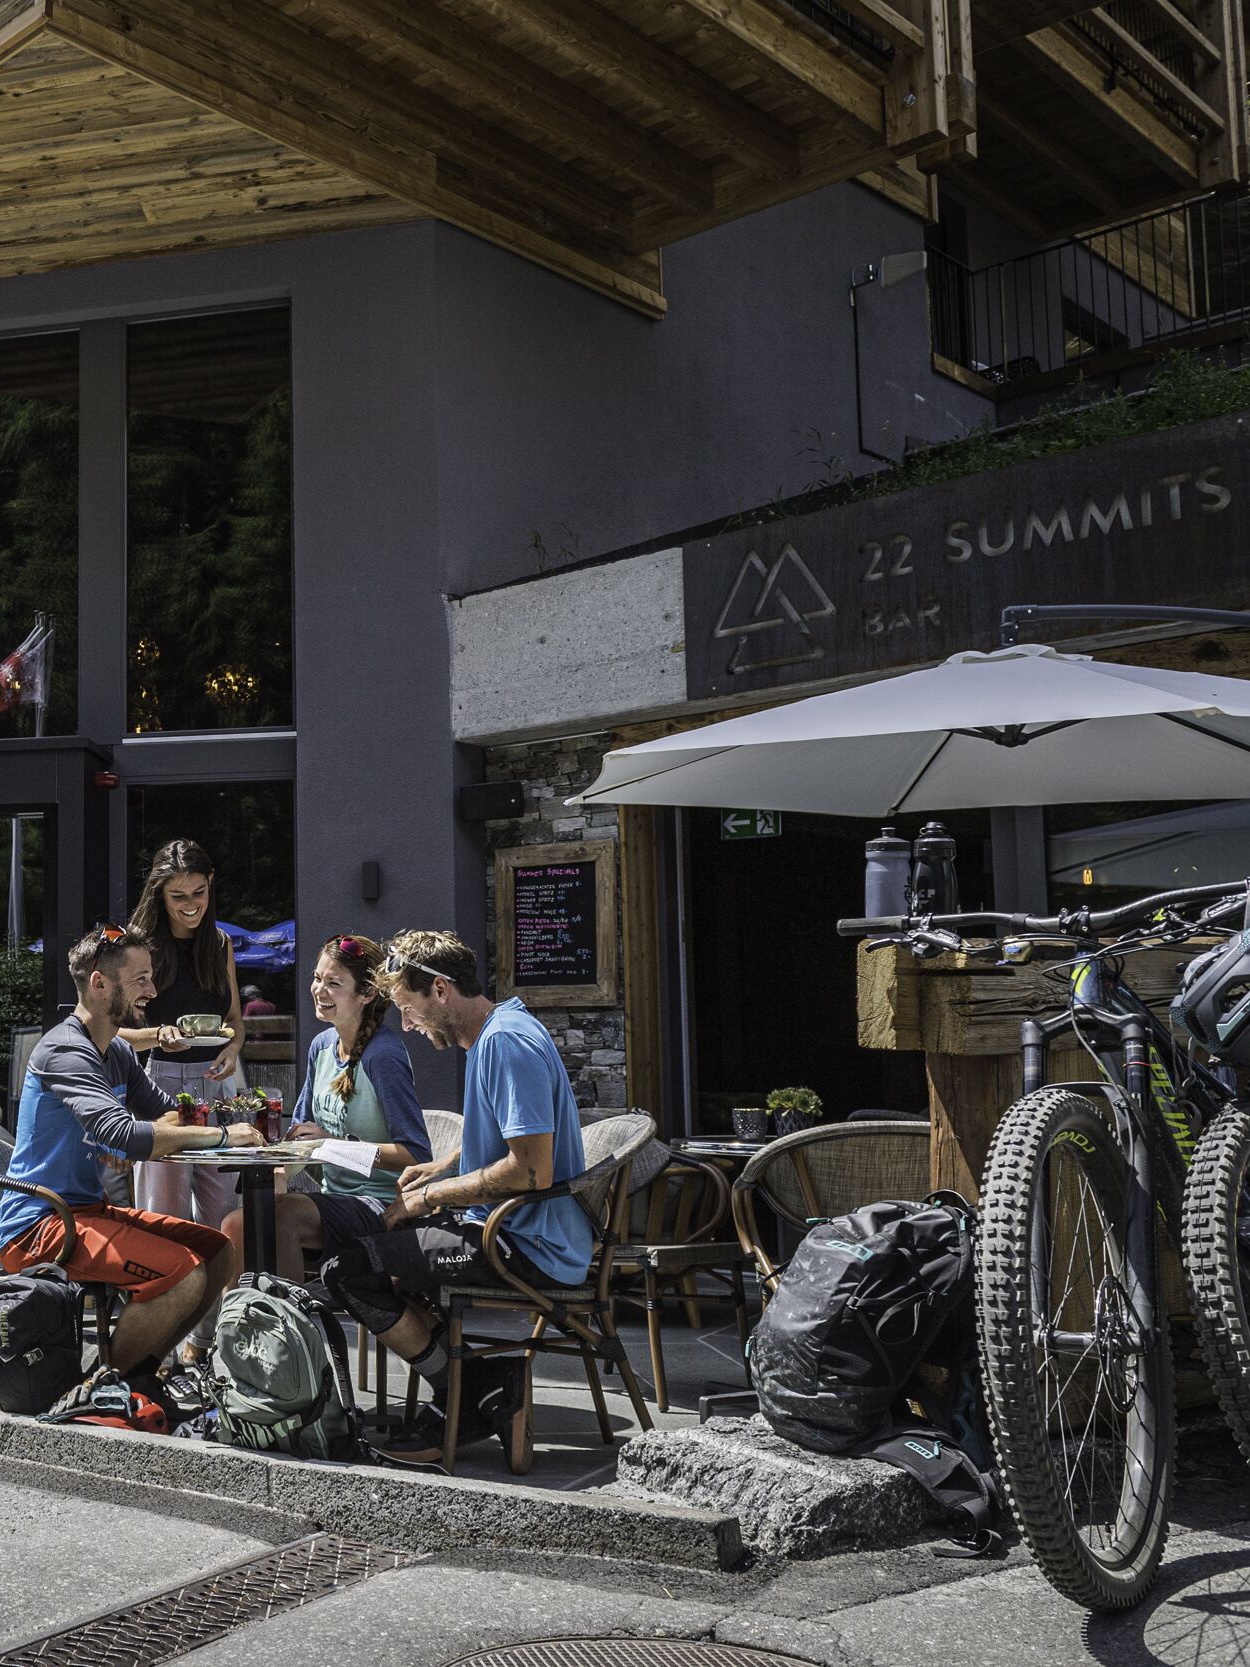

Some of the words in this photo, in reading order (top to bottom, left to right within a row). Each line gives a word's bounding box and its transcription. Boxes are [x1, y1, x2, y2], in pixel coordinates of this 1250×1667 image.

[859, 532, 914, 583] 22
[946, 466, 1232, 563] SUMMITS
[862, 597, 941, 635] BAR
[437, 1254, 473, 1264] MALOJA
